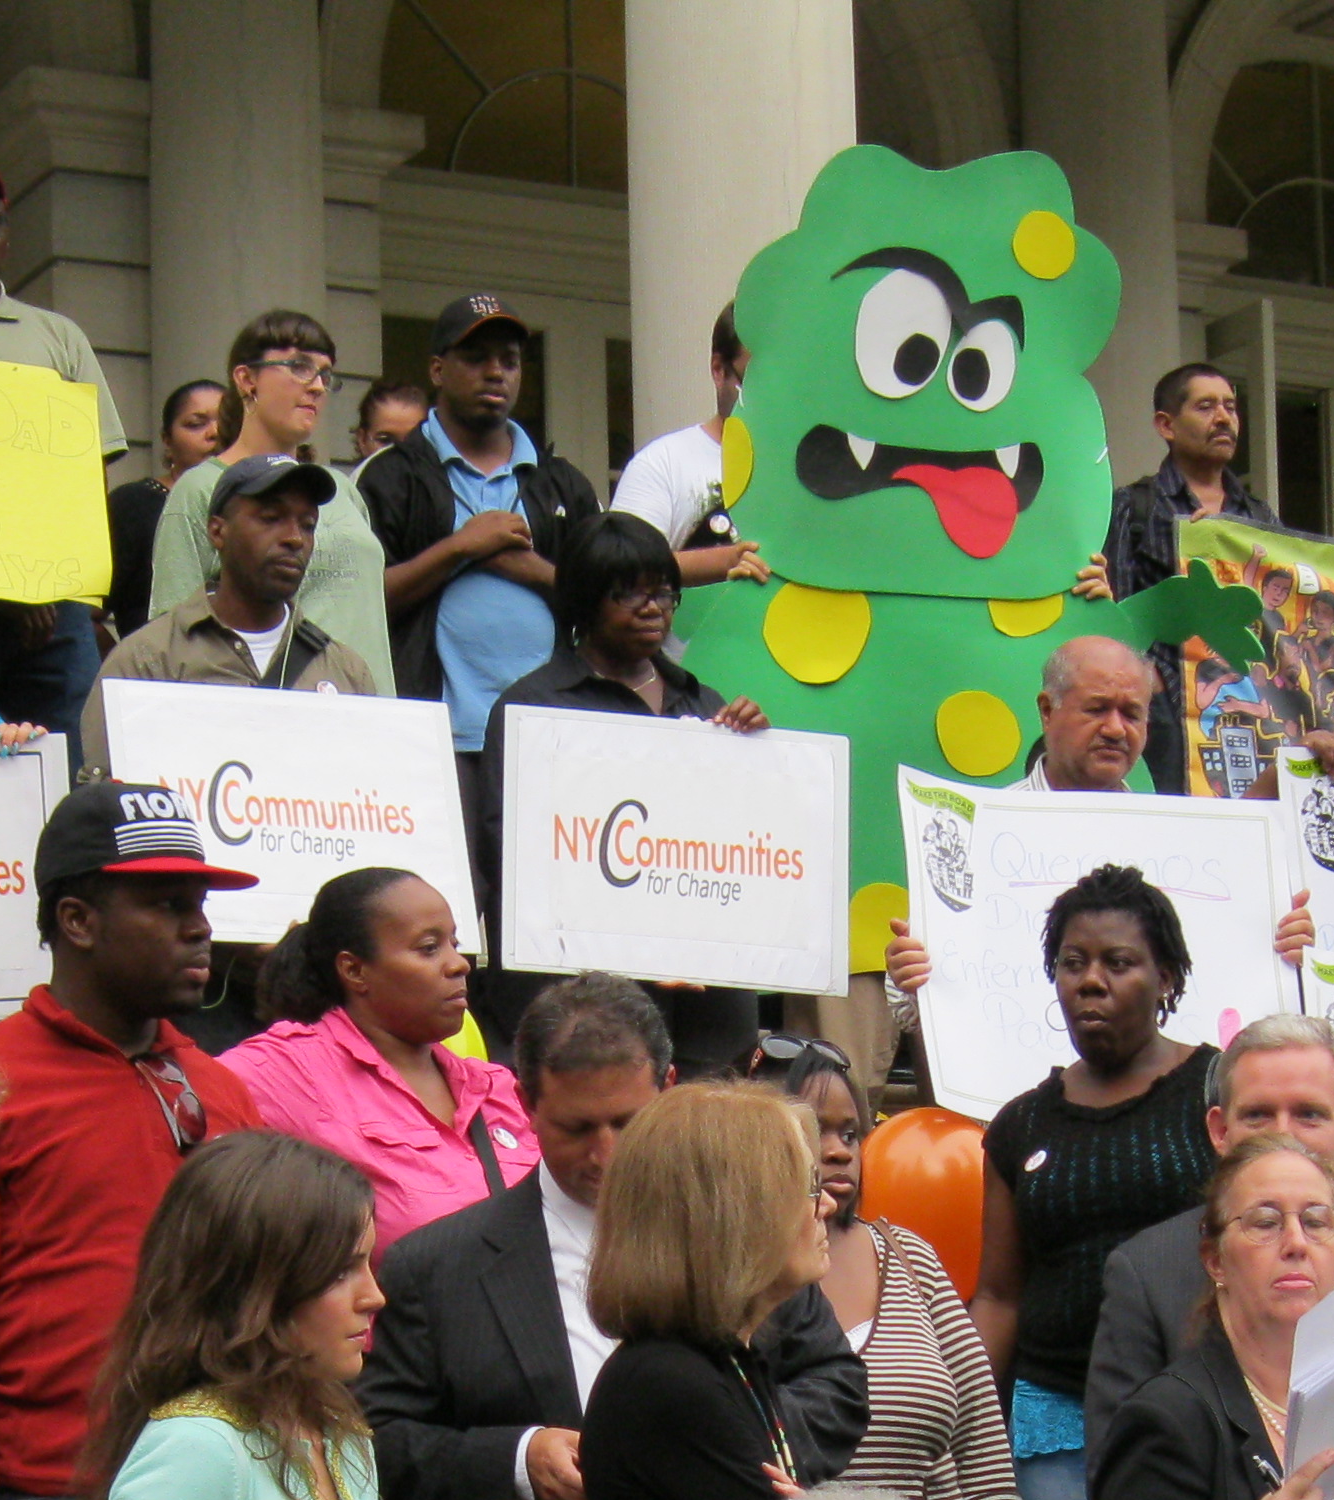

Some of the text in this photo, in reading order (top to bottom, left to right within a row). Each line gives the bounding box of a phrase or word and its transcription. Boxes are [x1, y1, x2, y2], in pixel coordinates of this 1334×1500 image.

[260, 826, 356, 863] for Change
[615, 819, 804, 881] Communities
[647, 870, 742, 906] for Change
